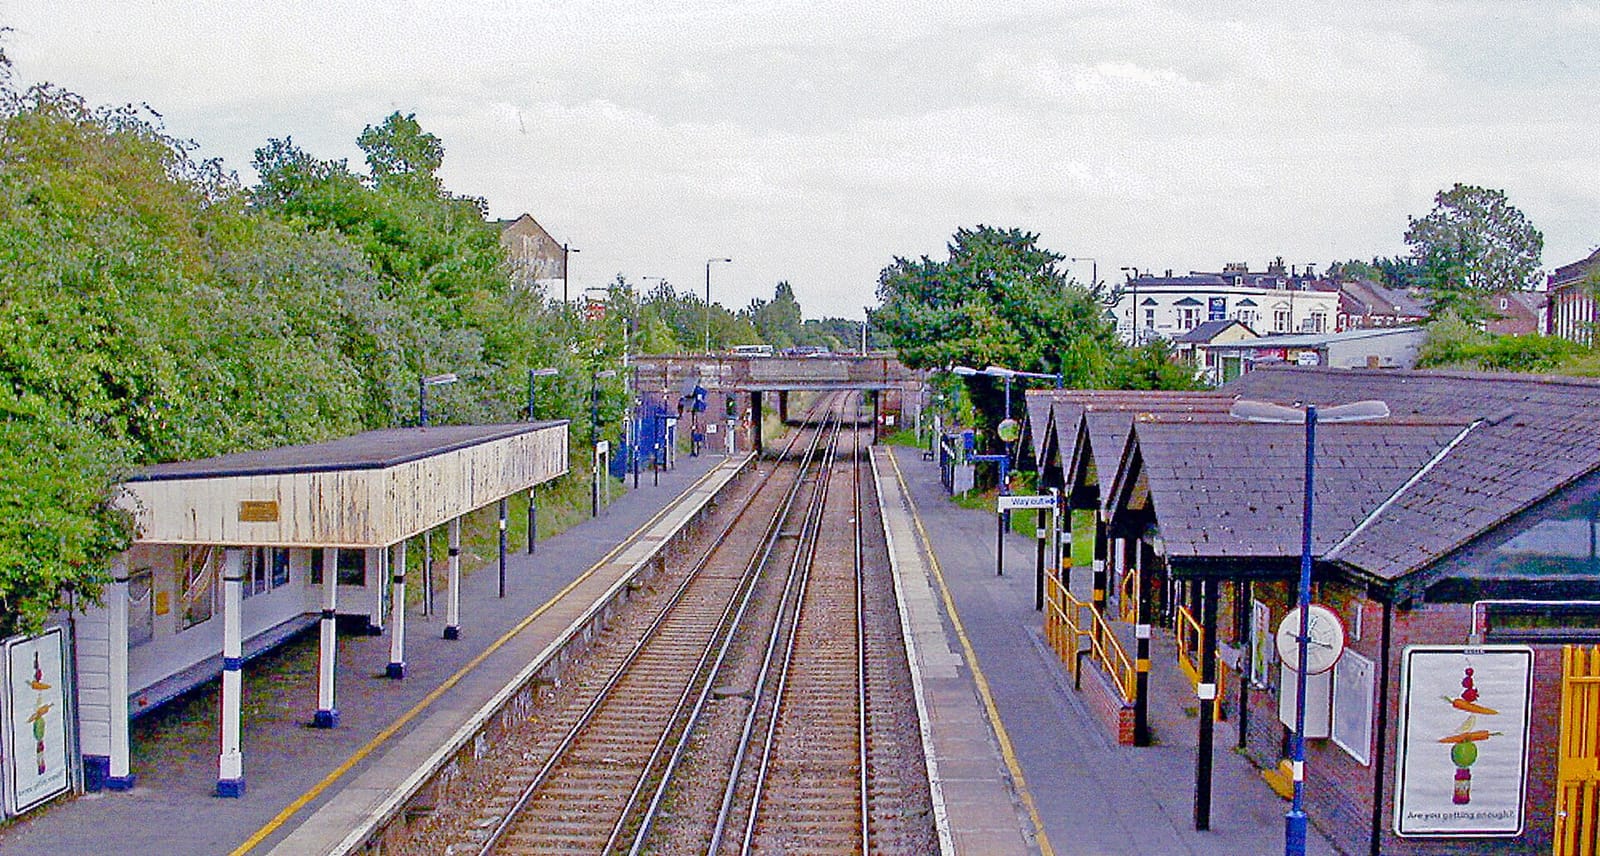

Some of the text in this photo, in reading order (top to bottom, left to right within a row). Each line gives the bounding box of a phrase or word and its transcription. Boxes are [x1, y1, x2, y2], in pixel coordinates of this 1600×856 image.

[1011, 498, 1029, 507] Way
[1424, 813, 1441, 821] you
[1442, 812, 1474, 820] getting
[1476, 809, 1515, 820] enough?
